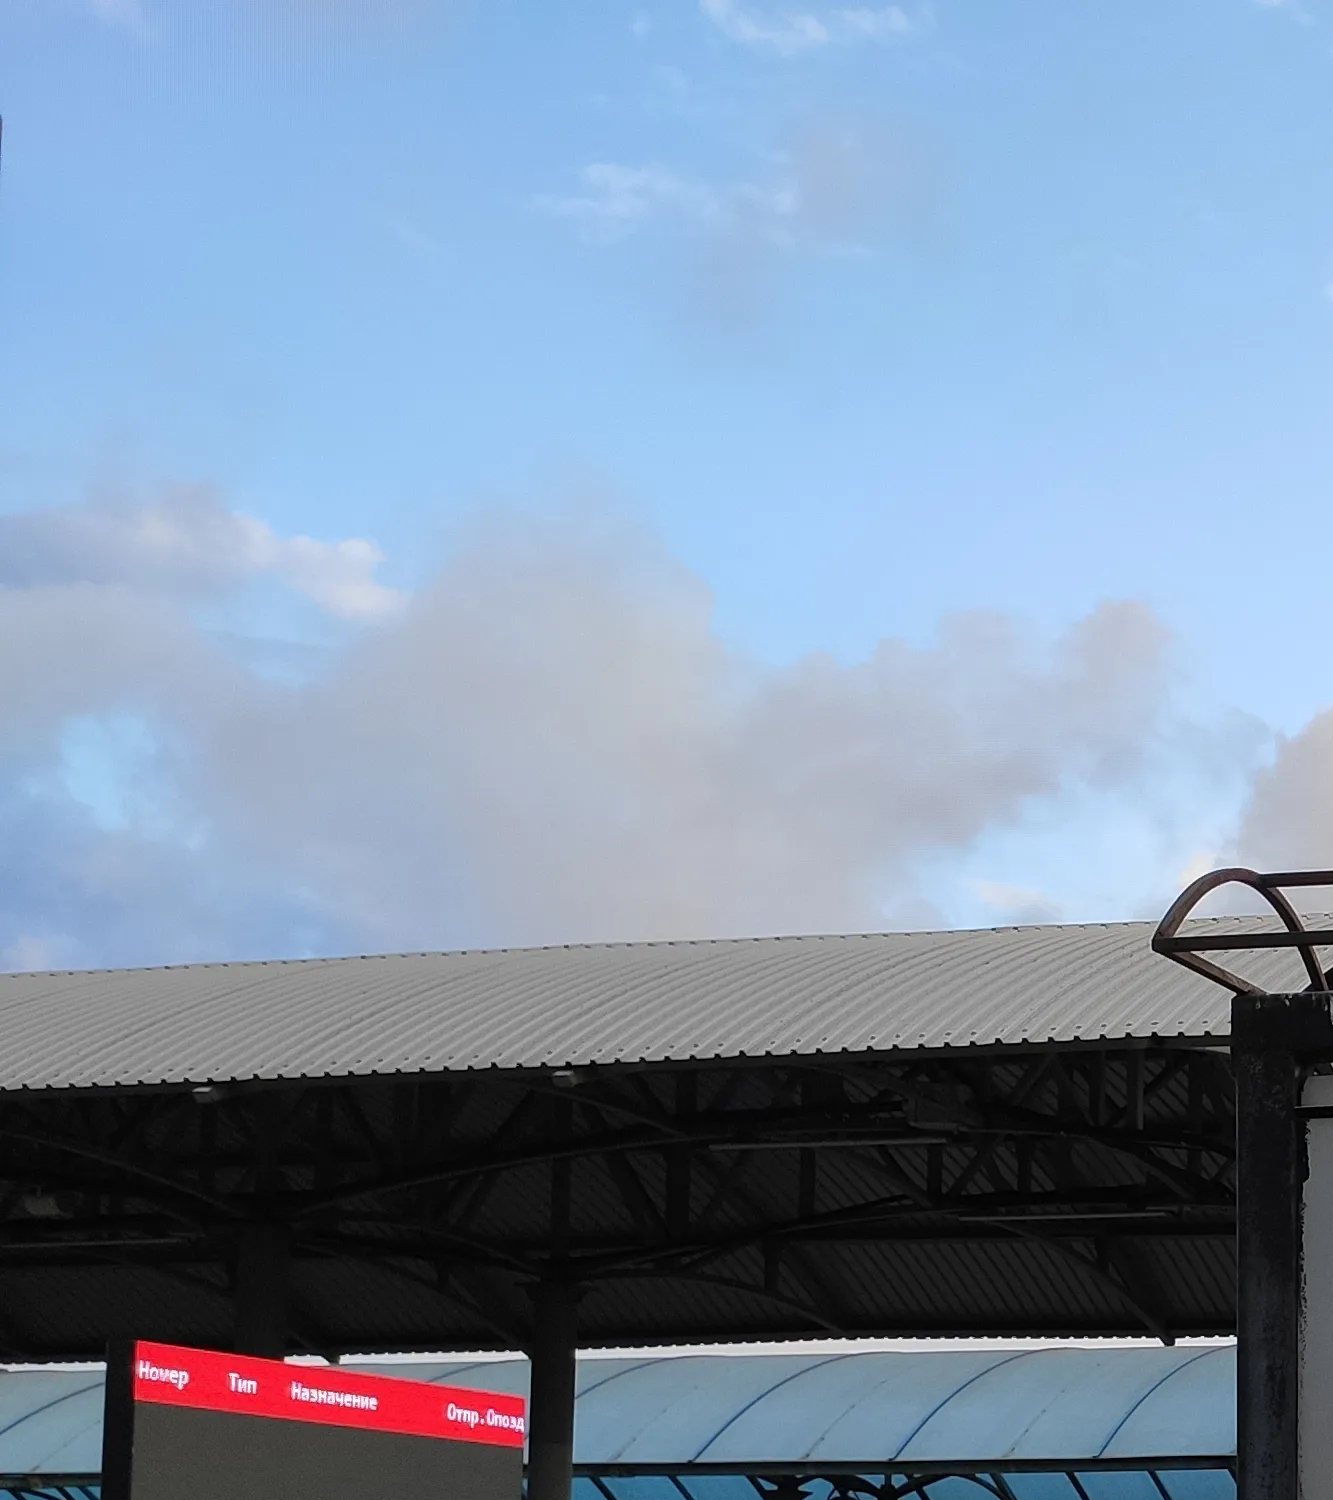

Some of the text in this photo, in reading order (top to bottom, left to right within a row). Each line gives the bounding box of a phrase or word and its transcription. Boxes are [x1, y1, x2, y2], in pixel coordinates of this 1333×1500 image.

[137, 1360, 190, 1391] Номер
[228, 1372, 258, 1395] Тип
[290, 1381, 379, 1411] Назначение
